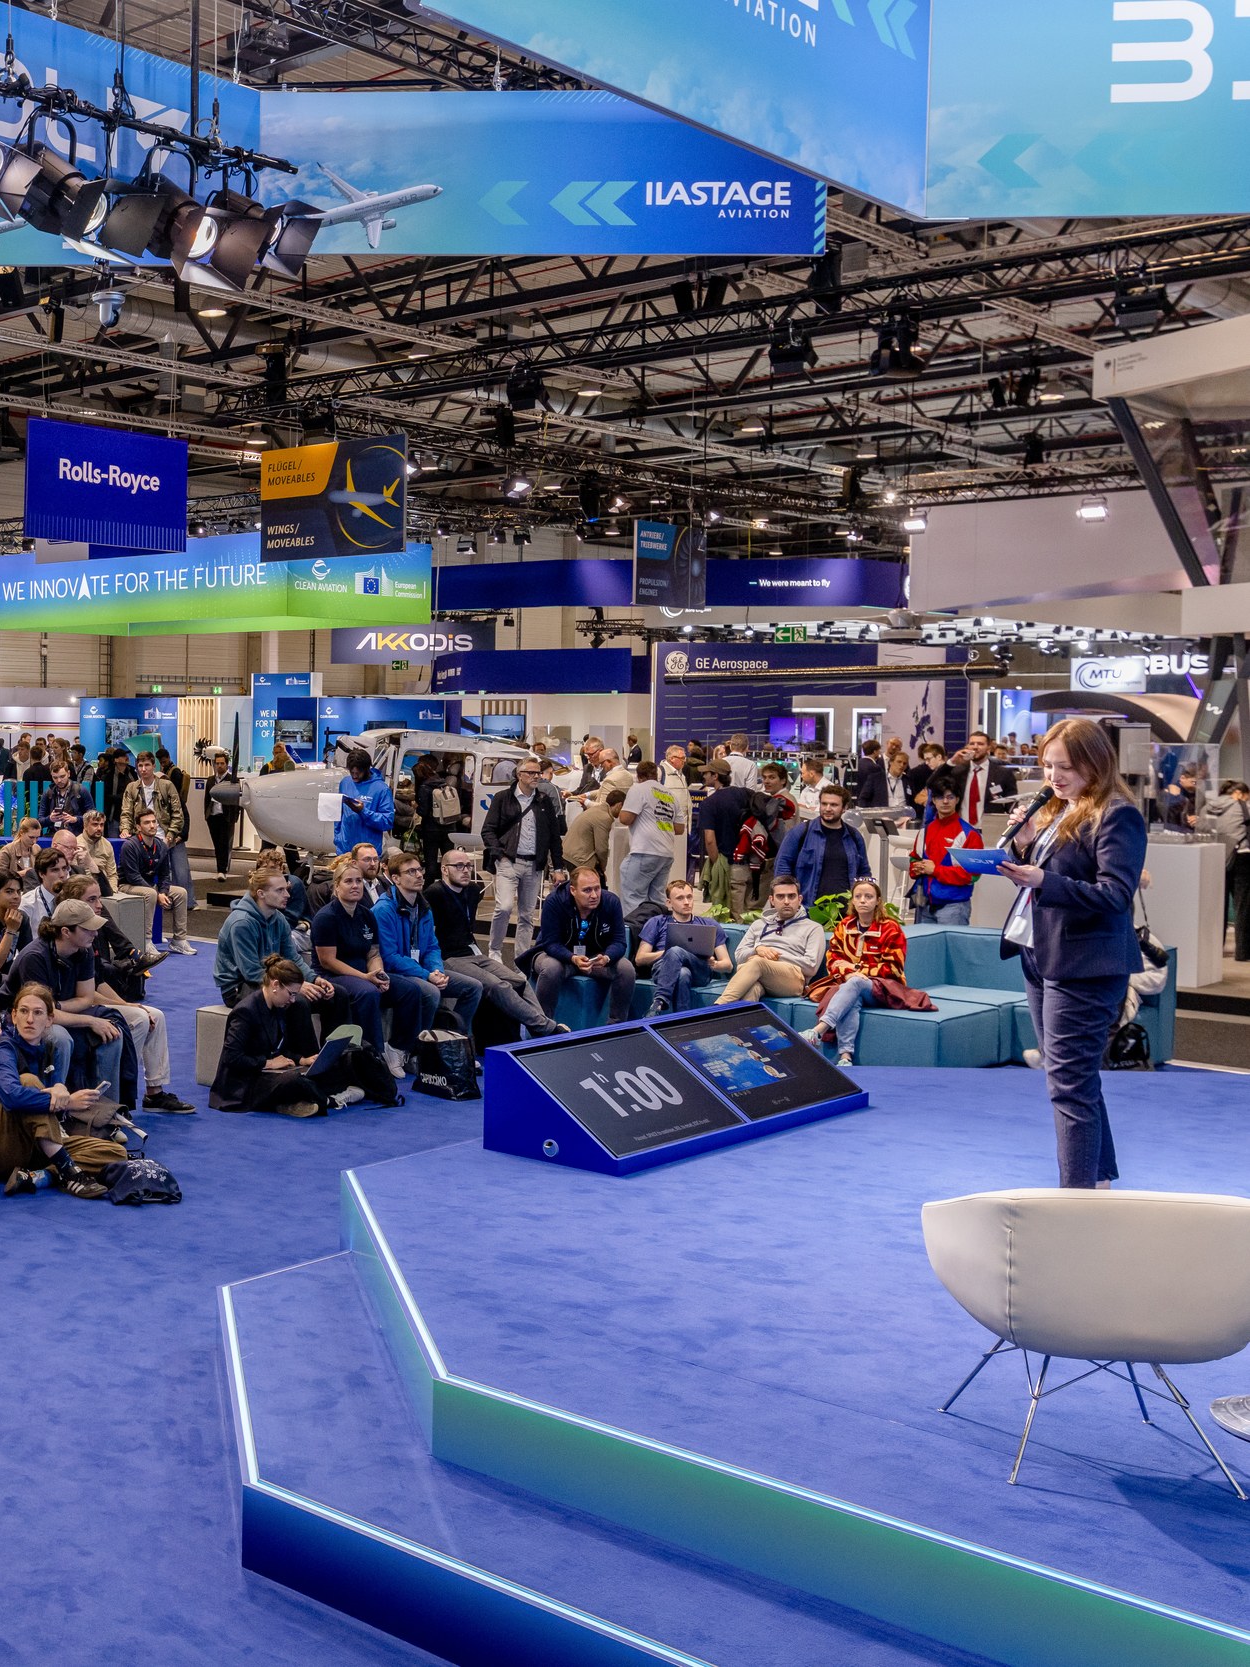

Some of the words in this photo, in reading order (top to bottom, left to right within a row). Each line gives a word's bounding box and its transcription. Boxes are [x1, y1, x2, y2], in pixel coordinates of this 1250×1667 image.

[718, 209, 790, 218] AVIATION
[59, 457, 160, 494] Rolls-Royce
[267, 472, 316, 486] MOVEABLES
[267, 523, 300, 535] WINGS/
[266, 536, 315, 549] MOVEABLES
[2, 582, 25, 601] WE
[115, 572, 149, 594] FOR
[154, 568, 189, 591] THE
[194, 563, 267, 588] FUTURE
[294, 580, 317, 590] CLEAN
[318, 582, 348, 593] AVIATION
[394, 581, 417, 590] European
[758, 579, 771, 587] We
[790, 579, 812, 587] meant
[812, 579, 821, 587] to
[821, 578, 831, 588] fly
[394, 590, 423, 599] Commission
[695, 658, 710, 669] GE
[711, 658, 769, 670] Aerospace
[1089, 668, 1122, 679] MTU
[255, 720, 268, 728] FOR
[579, 1066, 683, 1117] 1:00
